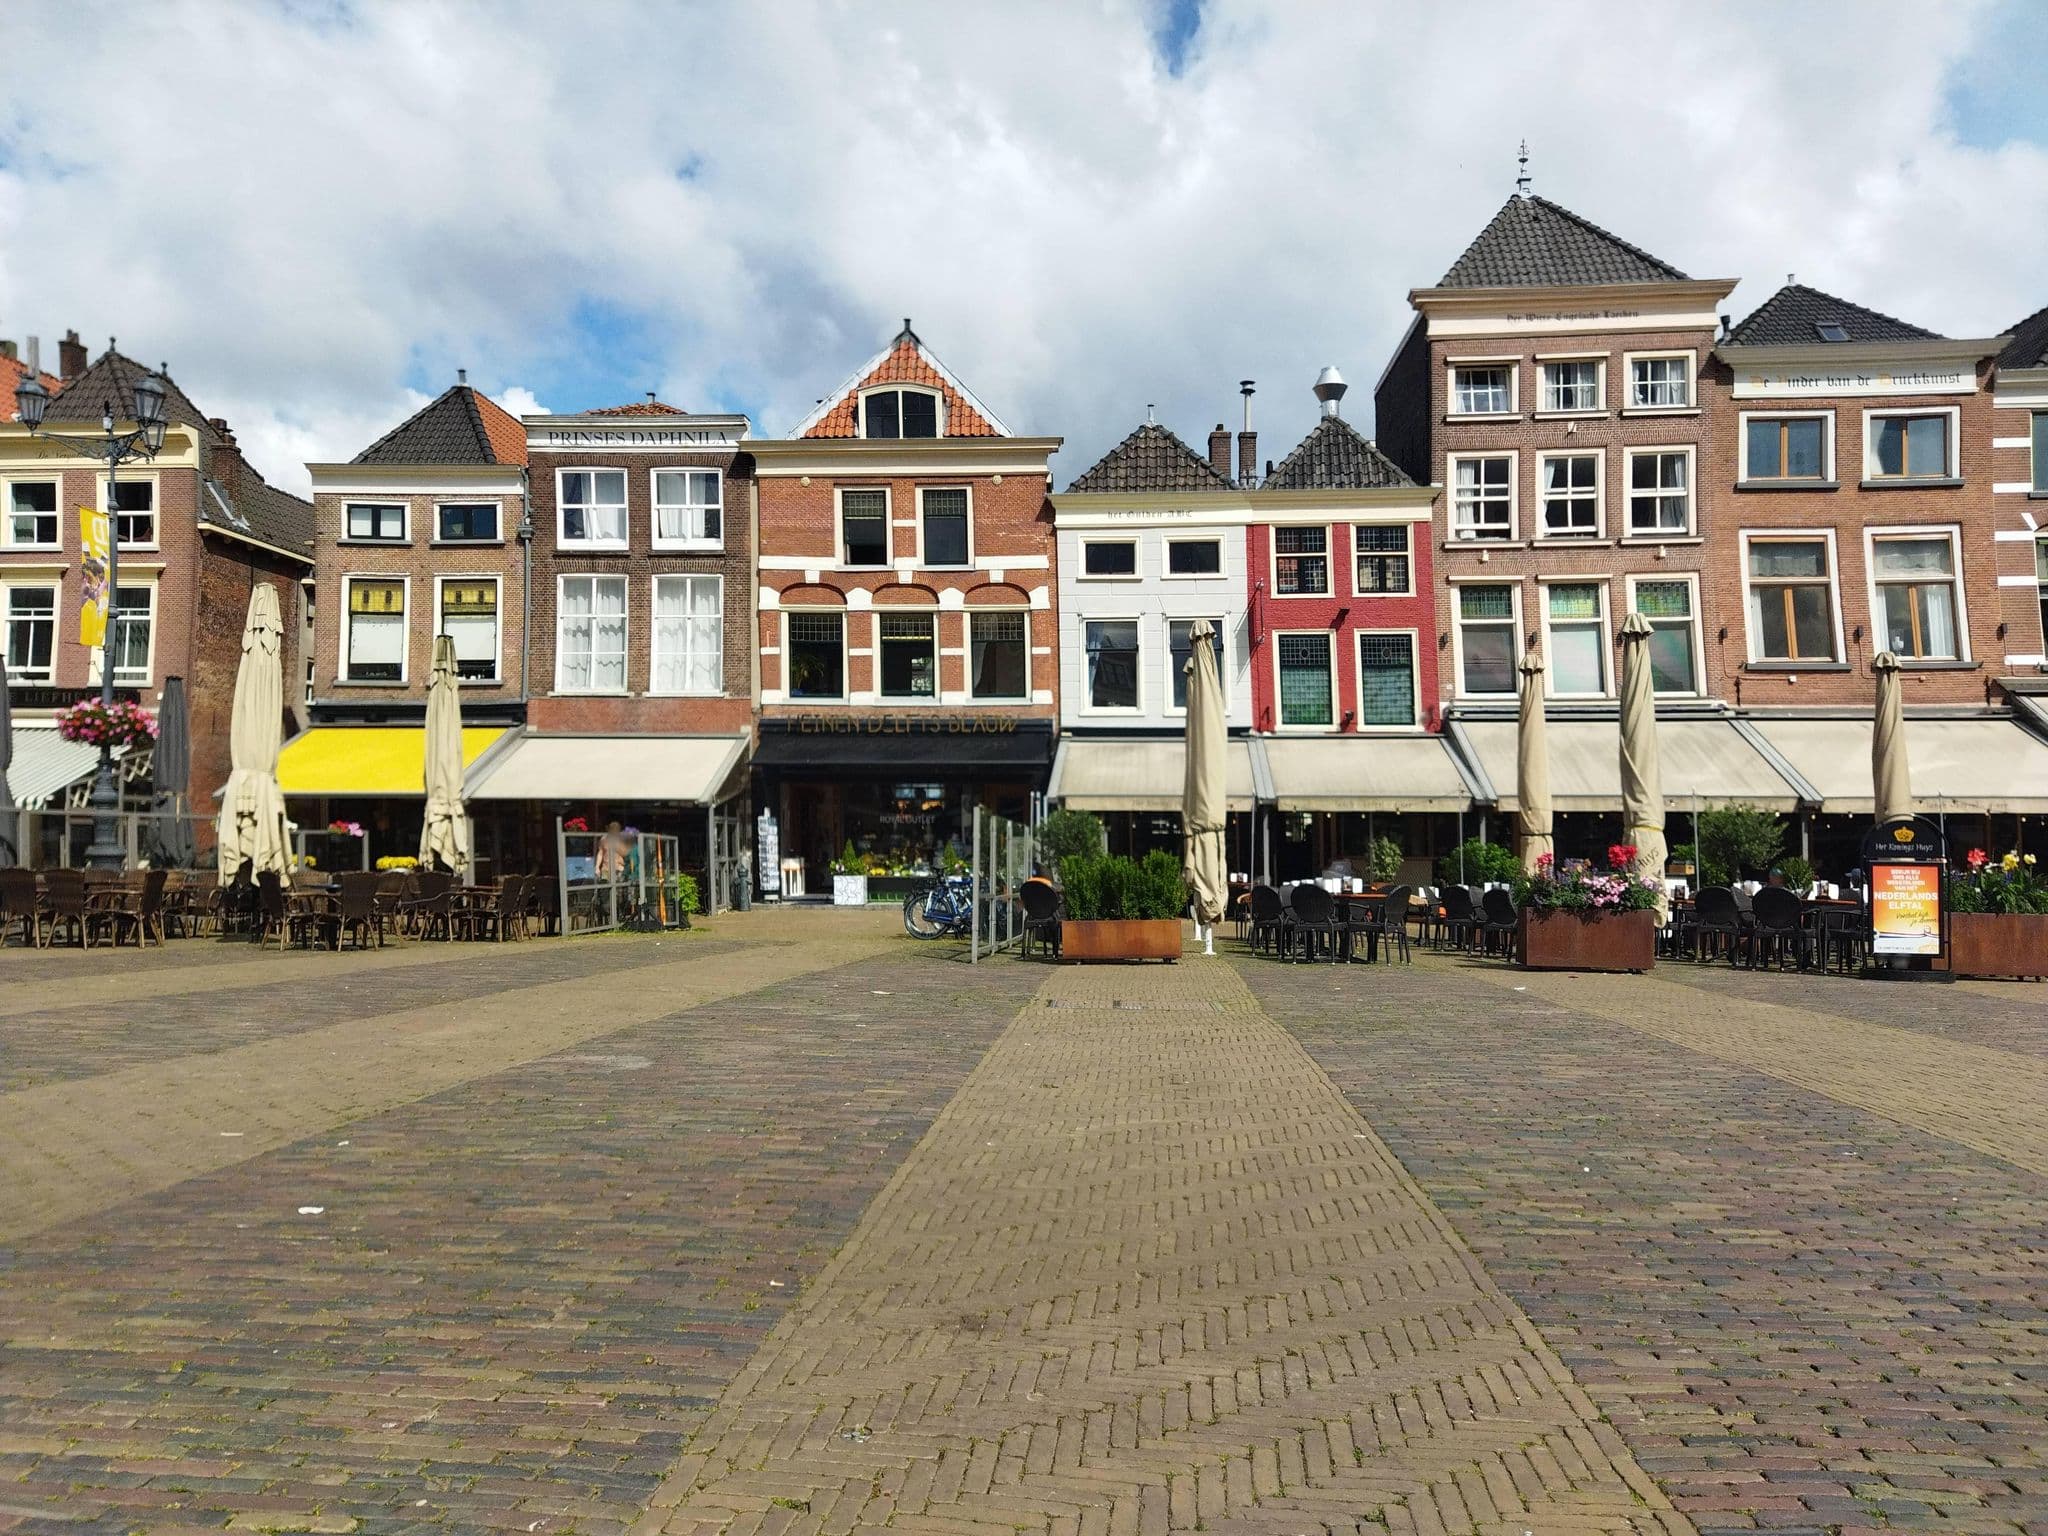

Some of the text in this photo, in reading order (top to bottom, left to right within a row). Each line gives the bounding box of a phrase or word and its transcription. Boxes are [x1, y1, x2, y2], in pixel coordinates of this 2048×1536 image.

[1827, 375, 1850, 387] van
[1856, 376, 1871, 387] de
[548, 431, 626, 445] PRINSES
[786, 713, 1019, 734] HEINEN DELFTS BLAUW
[1873, 891, 1938, 901] NEDERLANDS
[1888, 901, 1923, 910] ELFTAL
